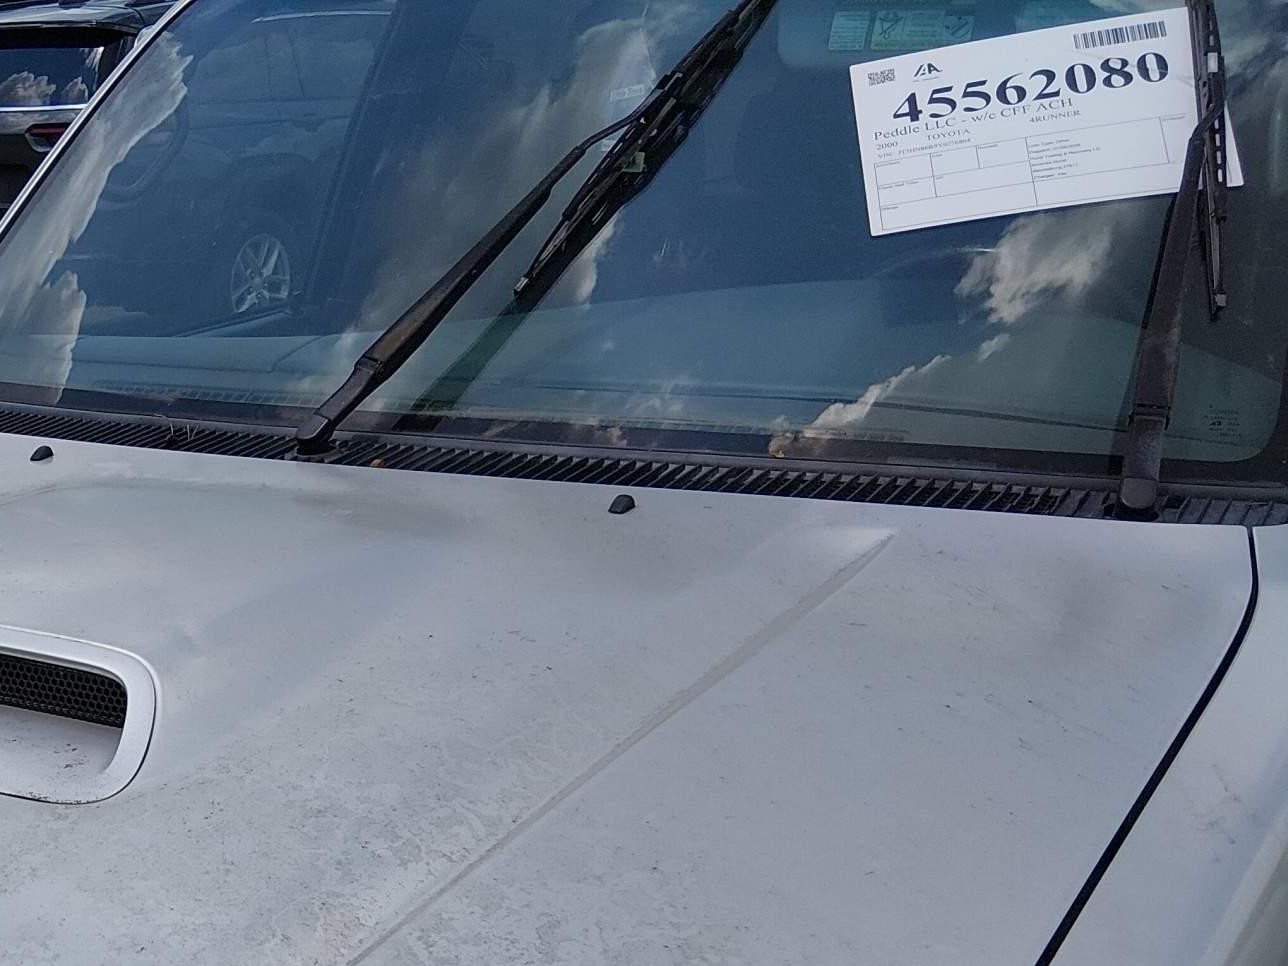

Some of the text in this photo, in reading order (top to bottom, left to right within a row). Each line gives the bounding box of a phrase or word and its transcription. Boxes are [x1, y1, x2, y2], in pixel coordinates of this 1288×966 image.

[893, 51, 1169, 123] 45562080
[873, 124, 920, 140] Peddle
[924, 117, 955, 131] LLC
[1036, 97, 1073, 112] ACH
[876, 140, 898, 151] 2000
[927, 127, 971, 141] TOYOTA
[1029, 109, 1081, 123] 4RUNNER
